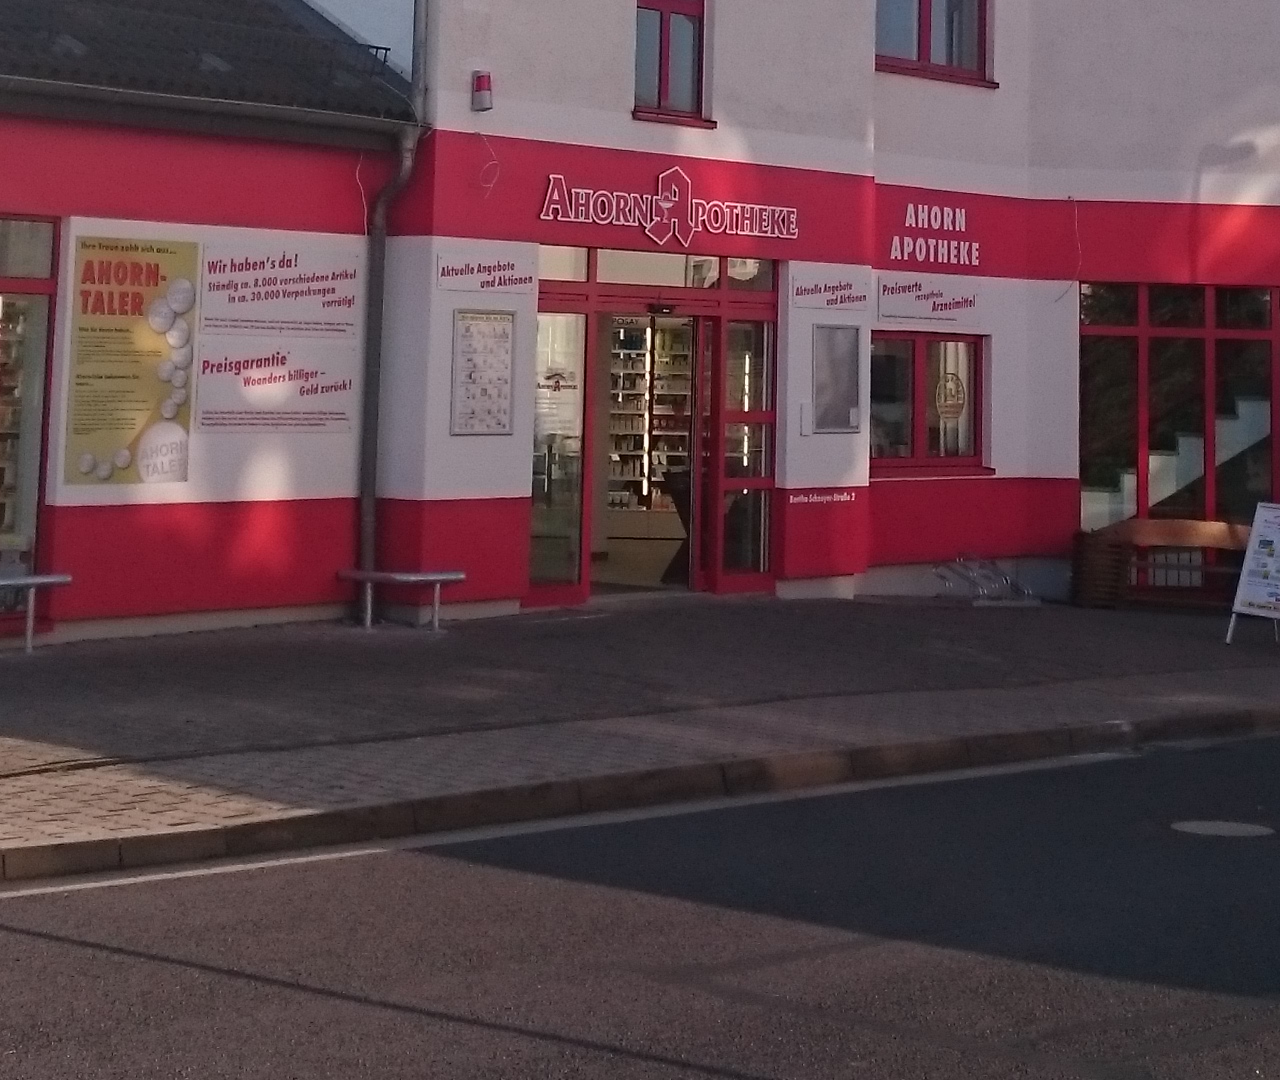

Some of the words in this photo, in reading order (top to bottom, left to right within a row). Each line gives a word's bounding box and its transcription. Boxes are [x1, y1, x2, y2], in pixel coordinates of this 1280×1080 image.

[905, 203, 966, 232] AHORN
[81, 242, 96, 250] Ihre
[890, 235, 980, 266] APOTHEKE
[81, 259, 167, 287] AHORN-
[207, 260, 228, 275] Wir
[230, 256, 276, 273] haben's
[278, 254, 299, 269] da!
[440, 262, 475, 278] Aktuelle
[476, 260, 516, 276] Angebote
[208, 280, 239, 293] Ständig
[240, 281, 252, 290] ca.
[253, 277, 278, 289] 8.000
[279, 272, 330, 286] verschiedene
[330, 269, 357, 281] Artikel
[480, 275, 496, 289] und
[497, 274, 534, 287] Aktionen
[795, 283, 822, 297] Aktuelle
[823, 280, 853, 295] Angebote
[882, 281, 923, 296] Preiswerte
[80, 290, 145, 316] TALER
[228, 294, 236, 304] in
[237, 295, 249, 304] ca.
[250, 291, 281, 302] 30.000
[281, 286, 336, 301] Verpackungen
[321, 295, 356, 309] vorrätig!
[826, 294, 838, 306] und
[839, 293, 867, 305] Aktionen
[202, 351, 288, 376] Preisgarantie
[243, 373, 286, 388] Woanders
[288, 369, 319, 383] billiger
[299, 384, 318, 397] Geld
